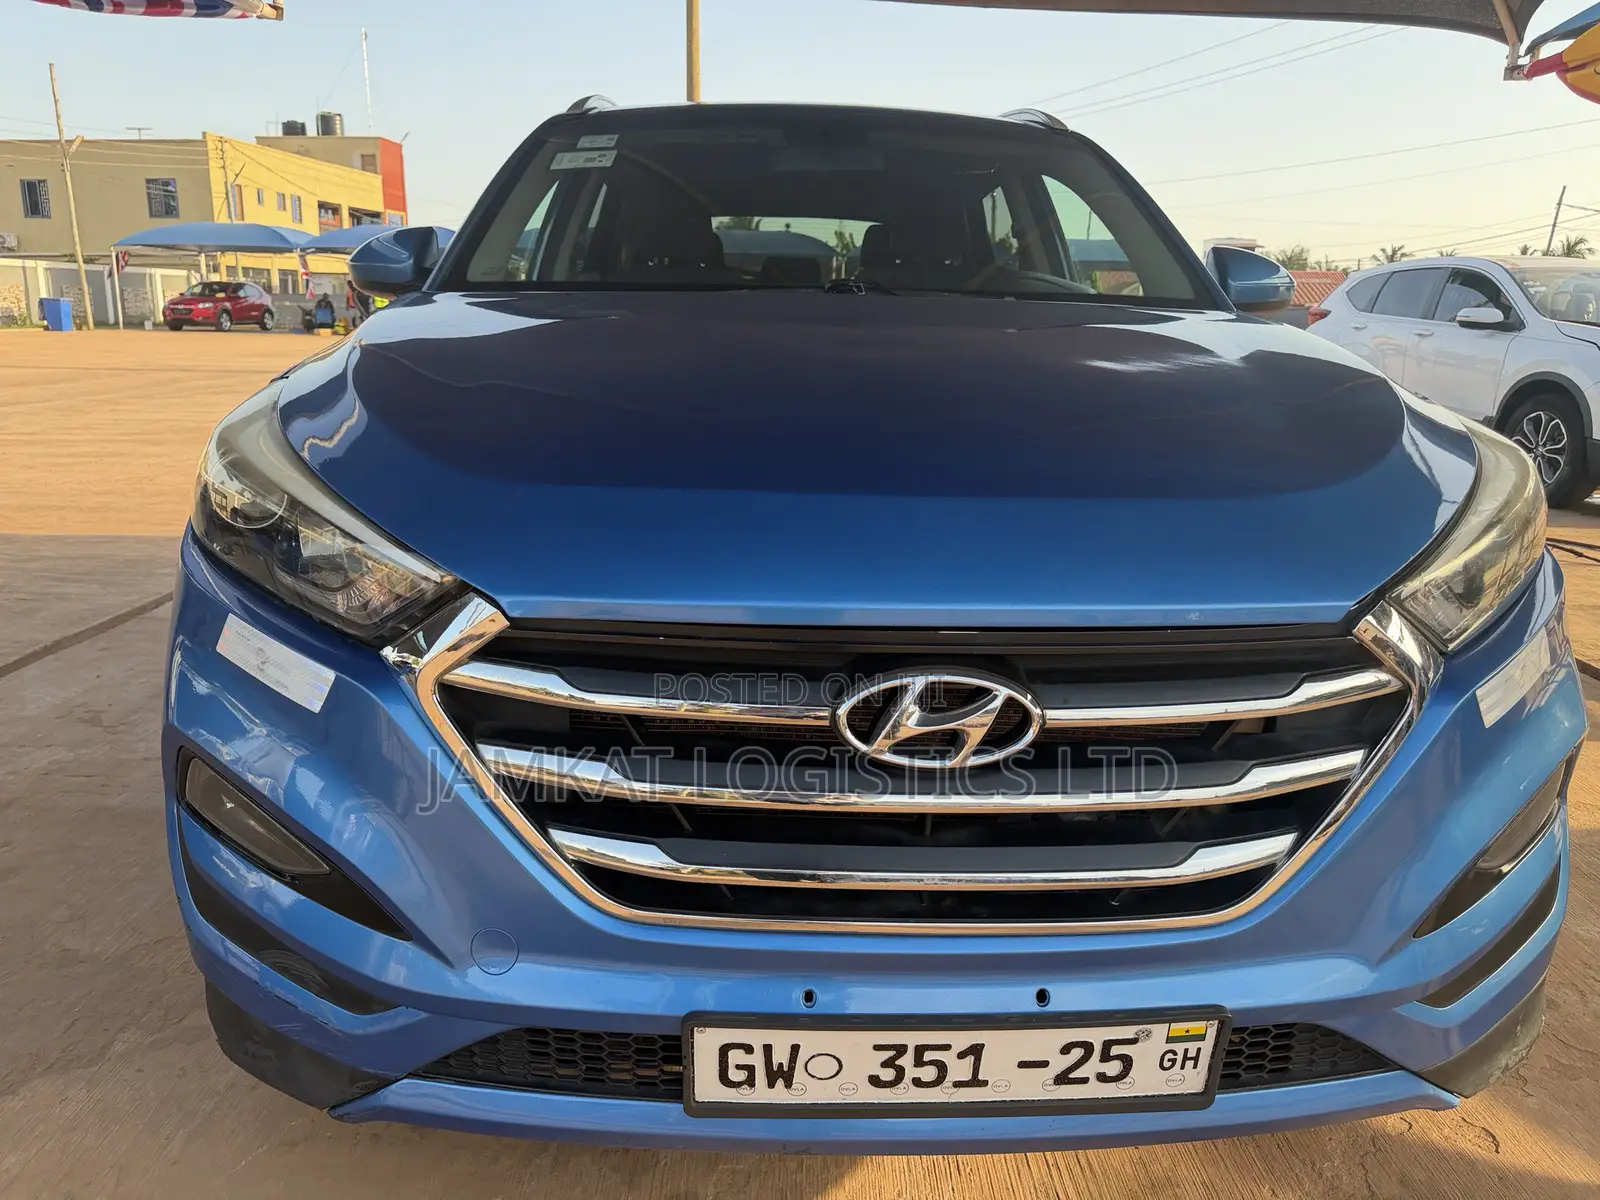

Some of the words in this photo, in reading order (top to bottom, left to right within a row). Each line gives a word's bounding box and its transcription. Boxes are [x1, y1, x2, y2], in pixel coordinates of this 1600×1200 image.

[718, 1042, 801, 1089] GW
[867, 1043, 989, 1089] 351
[1159, 1047, 1202, 1071] GH
